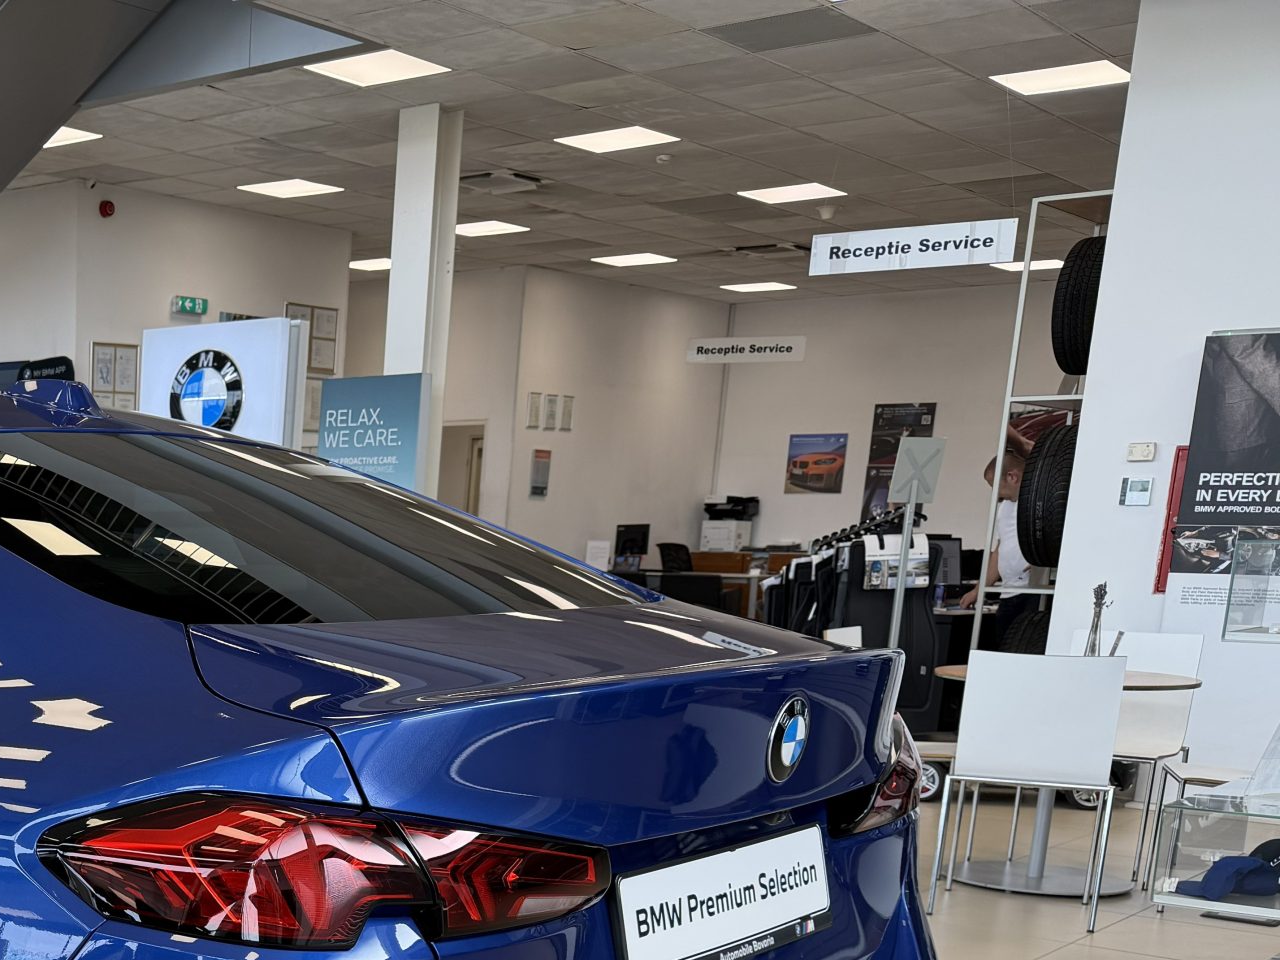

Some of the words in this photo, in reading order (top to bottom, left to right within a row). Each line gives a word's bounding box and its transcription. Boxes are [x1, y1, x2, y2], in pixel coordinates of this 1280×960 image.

[828, 241, 912, 260] Receptie
[917, 235, 994, 252] Service
[696, 344, 745, 356] Receptie
[748, 344, 793, 353] Service
[325, 408, 384, 427] RELAX.
[324, 430, 350, 448] WE
[353, 428, 402, 448] CARE.
[1196, 489, 1212, 502] IN
[1216, 489, 1272, 502] EVERY
[635, 897, 682, 938] BMW
[686, 882, 757, 923] Premium
[758, 862, 818, 900] Selection
[753, 935, 775, 952] Bavaria
